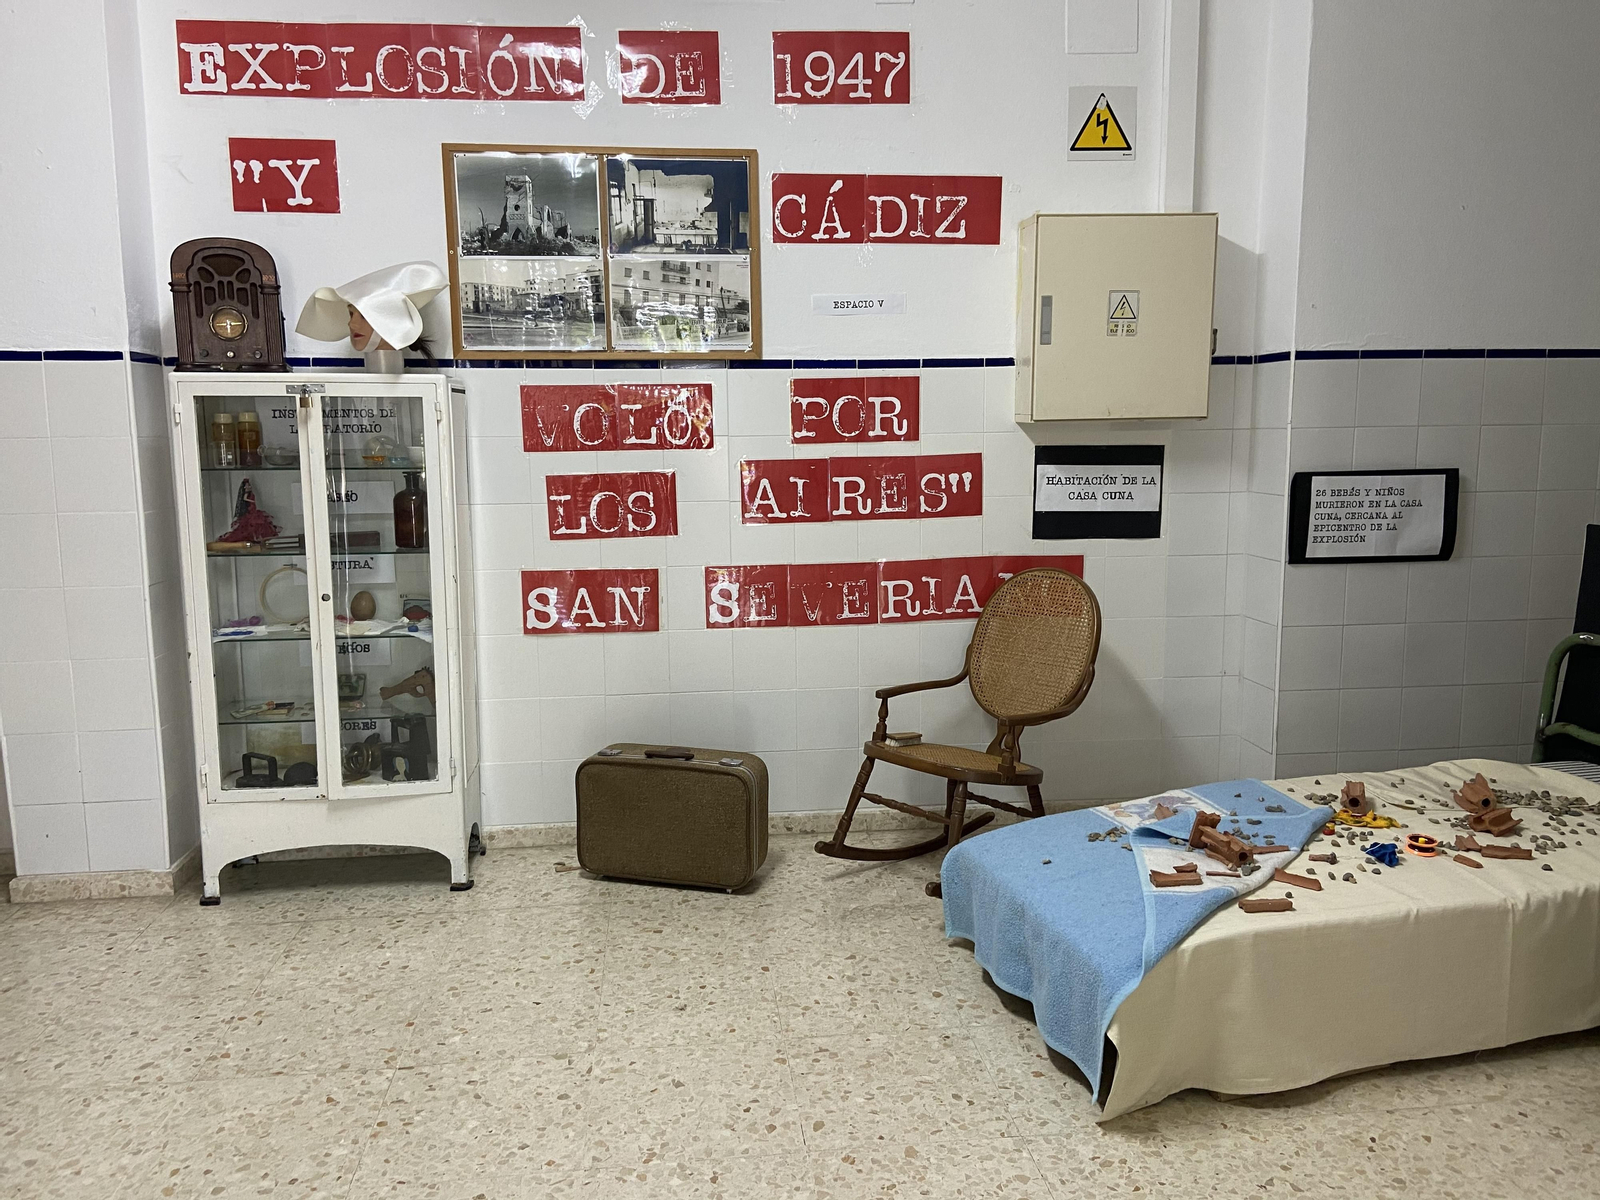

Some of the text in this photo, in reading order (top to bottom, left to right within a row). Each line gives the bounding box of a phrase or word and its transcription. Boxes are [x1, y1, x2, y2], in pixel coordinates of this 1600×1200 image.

[180, 33, 906, 99] EXPLOSIÓN DE 1947
[774, 180, 969, 240] CÁDIZ
[833, 300, 884, 309] ESPACIO V
[271, 408, 397, 419] INSMENTOS DE
[793, 395, 908, 438] POR
[289, 422, 383, 434] LRATORIO
[1045, 474, 1157, 486] HABITACIÓN DE LA
[1068, 491, 1134, 501] CASA CUNA
[1315, 487, 1405, 497] 26 BEBÉS Y NIÑOS
[1315, 499, 1423, 510] MURIERON EN LA CASA
[549, 491, 657, 534] LOS
[1314, 511, 1403, 522] CUNA, CERCANA AL
[1313, 523, 1398, 532] EPICENTRO DE LA
[1312, 533, 1366, 544] EXPLOSIÓN
[526, 573, 1013, 630] SAN SEVERIA
